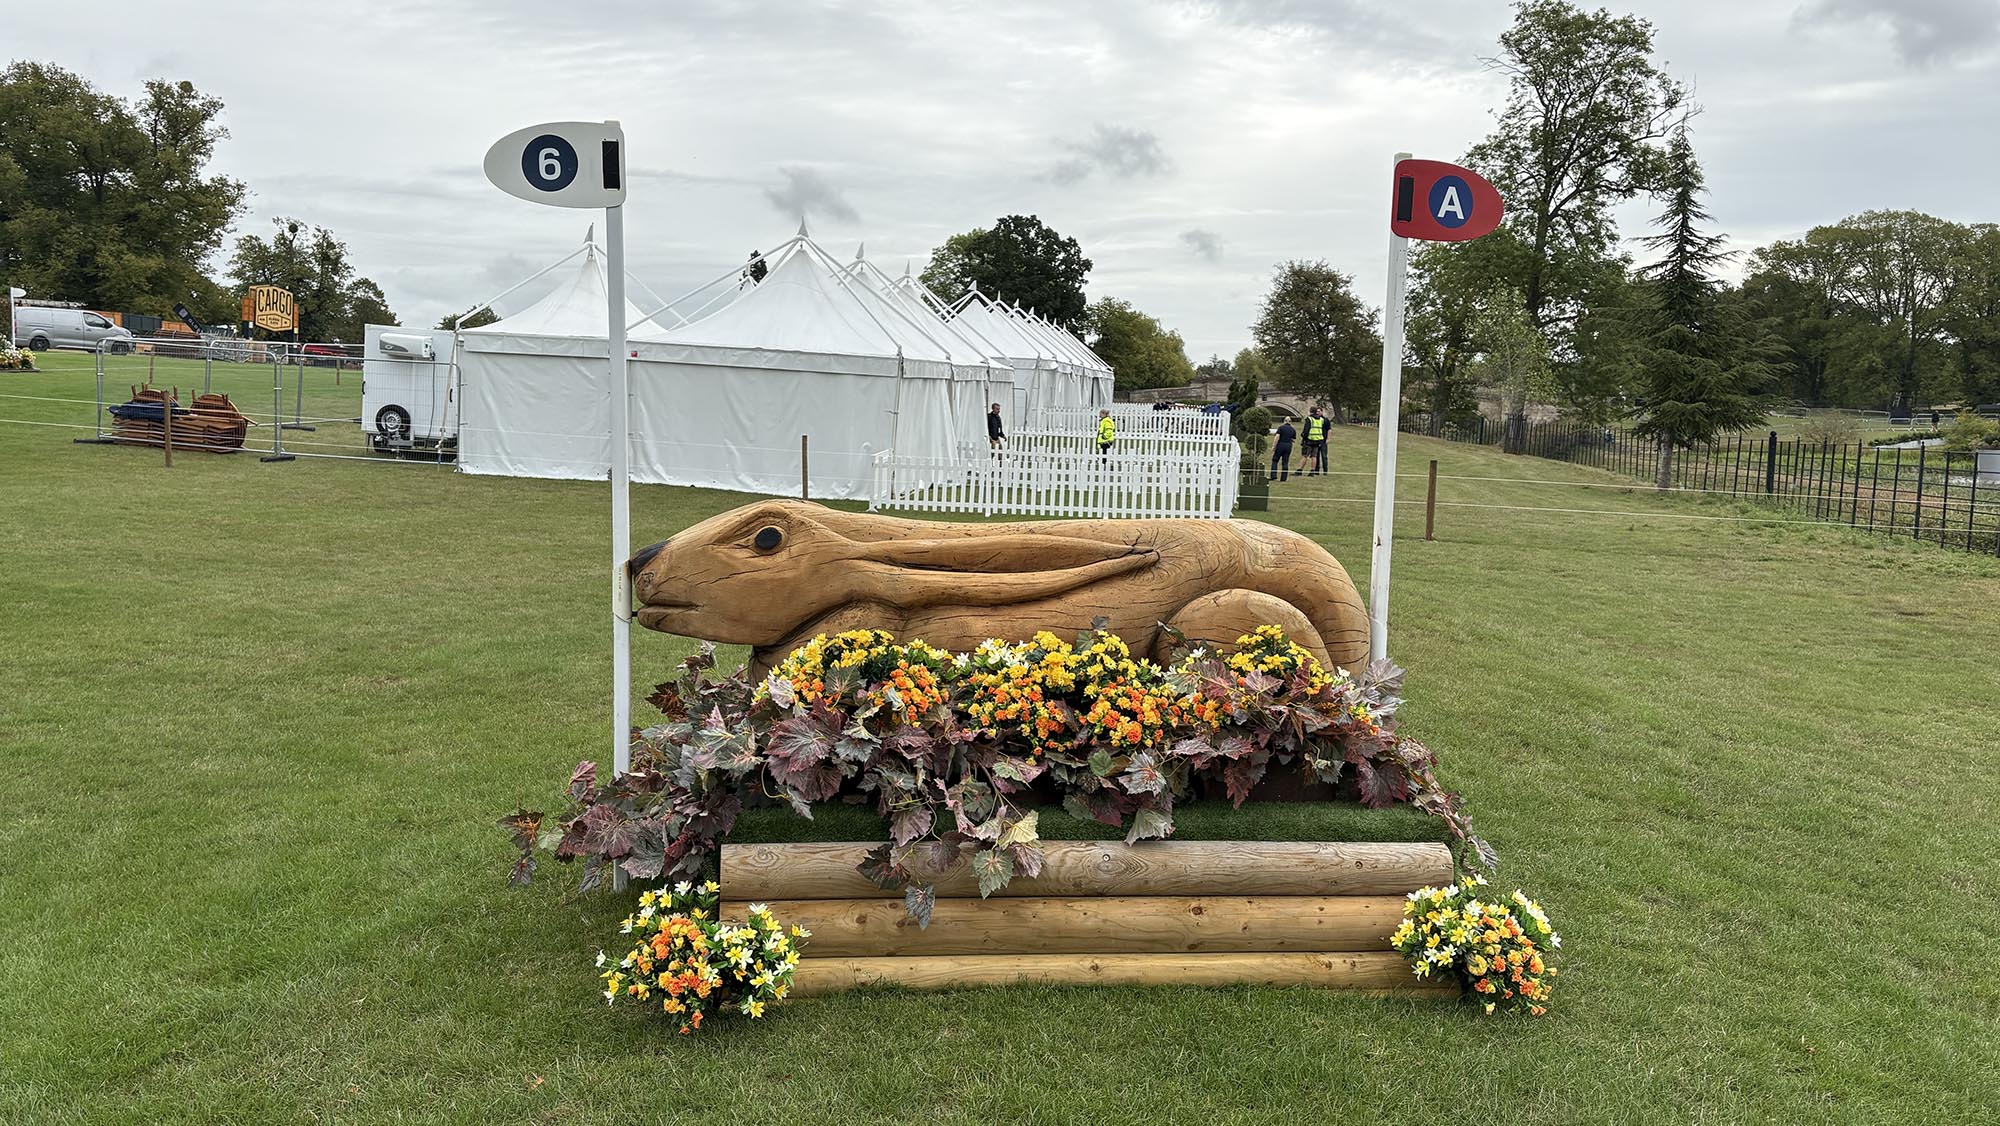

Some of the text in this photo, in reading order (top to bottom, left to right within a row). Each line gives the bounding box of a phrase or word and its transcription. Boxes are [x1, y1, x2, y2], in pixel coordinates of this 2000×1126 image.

[538, 147, 562, 181] 6
[1437, 186, 1465, 220] A
[258, 288, 292, 316] CARGO
